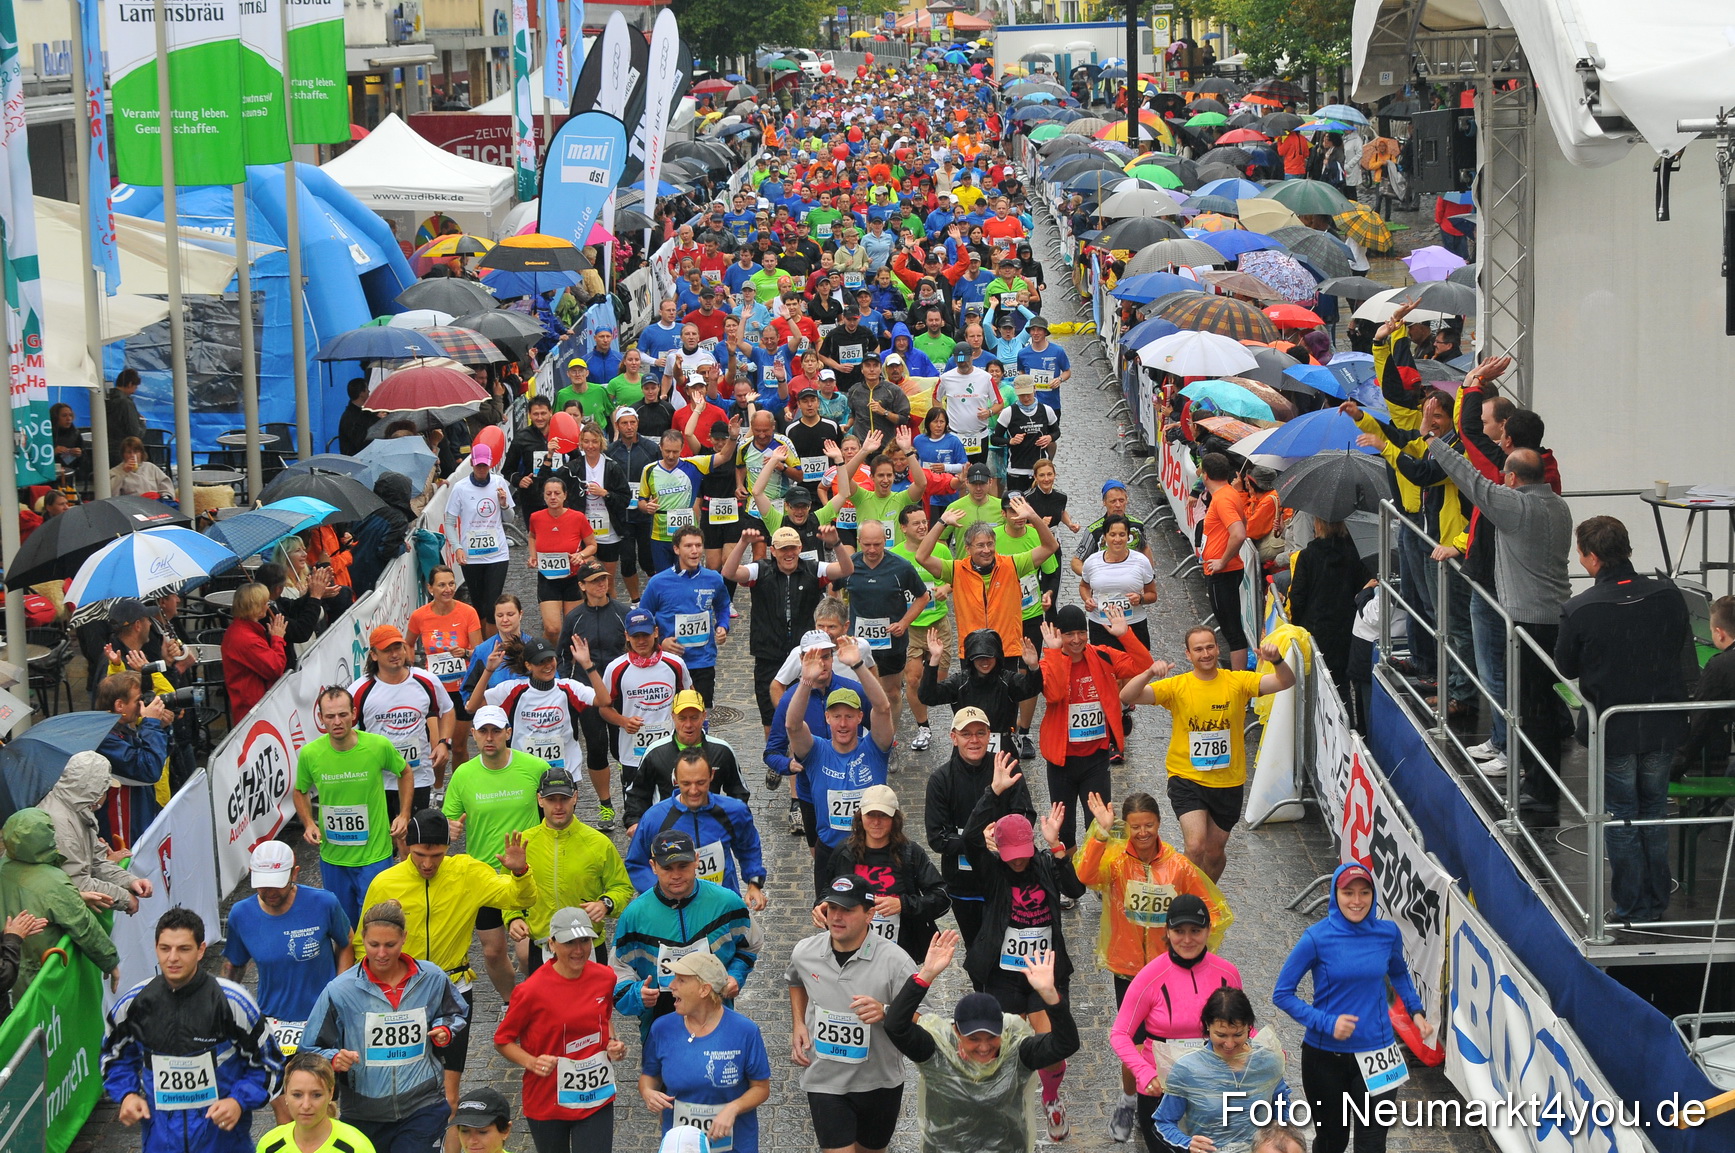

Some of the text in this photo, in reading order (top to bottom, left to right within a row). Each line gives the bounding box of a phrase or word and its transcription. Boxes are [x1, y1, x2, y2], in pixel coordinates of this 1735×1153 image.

[122, 108, 229, 121] Verantwrtung leben.
[174, 123, 219, 134] schaffen.
[567, 141, 610, 161] maxi
[589, 169, 604, 184] dsl
[372, 192, 464, 202] www.audibkk.de
[841, 350, 861, 359] 2857
[1033, 375, 1049, 384] 514
[962, 437, 977, 446] 284
[803, 461, 827, 473] 2927
[715, 504, 733, 515] 536
[670, 515, 693, 527] 2806
[840, 512, 857, 523] 326
[469, 536, 496, 548] 2738
[541, 558, 567, 569] 3420
[679, 621, 707, 636] 3374
[857, 626, 888, 639] 2459
[432, 659, 462, 675] 2734
[627, 686, 665, 696] GERHART
[375, 711, 414, 720] GERHART
[1072, 710, 1103, 728] 2820
[527, 745, 561, 760] 3143
[1193, 739, 1228, 757] 2786
[833, 800, 861, 816] 275
[326, 814, 365, 831] 3186
[334, 832, 358, 840] Thomas
[697, 854, 718, 876] 94
[1129, 893, 1173, 913] 3269
[1007, 938, 1048, 957] 3019
[371, 1023, 422, 1047] 2883
[817, 1021, 865, 1046] 2539
[386, 1049, 407, 1059] Julia
[830, 1045, 847, 1057] Jörg
[1364, 1043, 1402, 1076] 2849
[159, 1068, 210, 1090] 2884
[563, 1065, 610, 1091] 2352
[162, 1090, 209, 1104] Christopher
